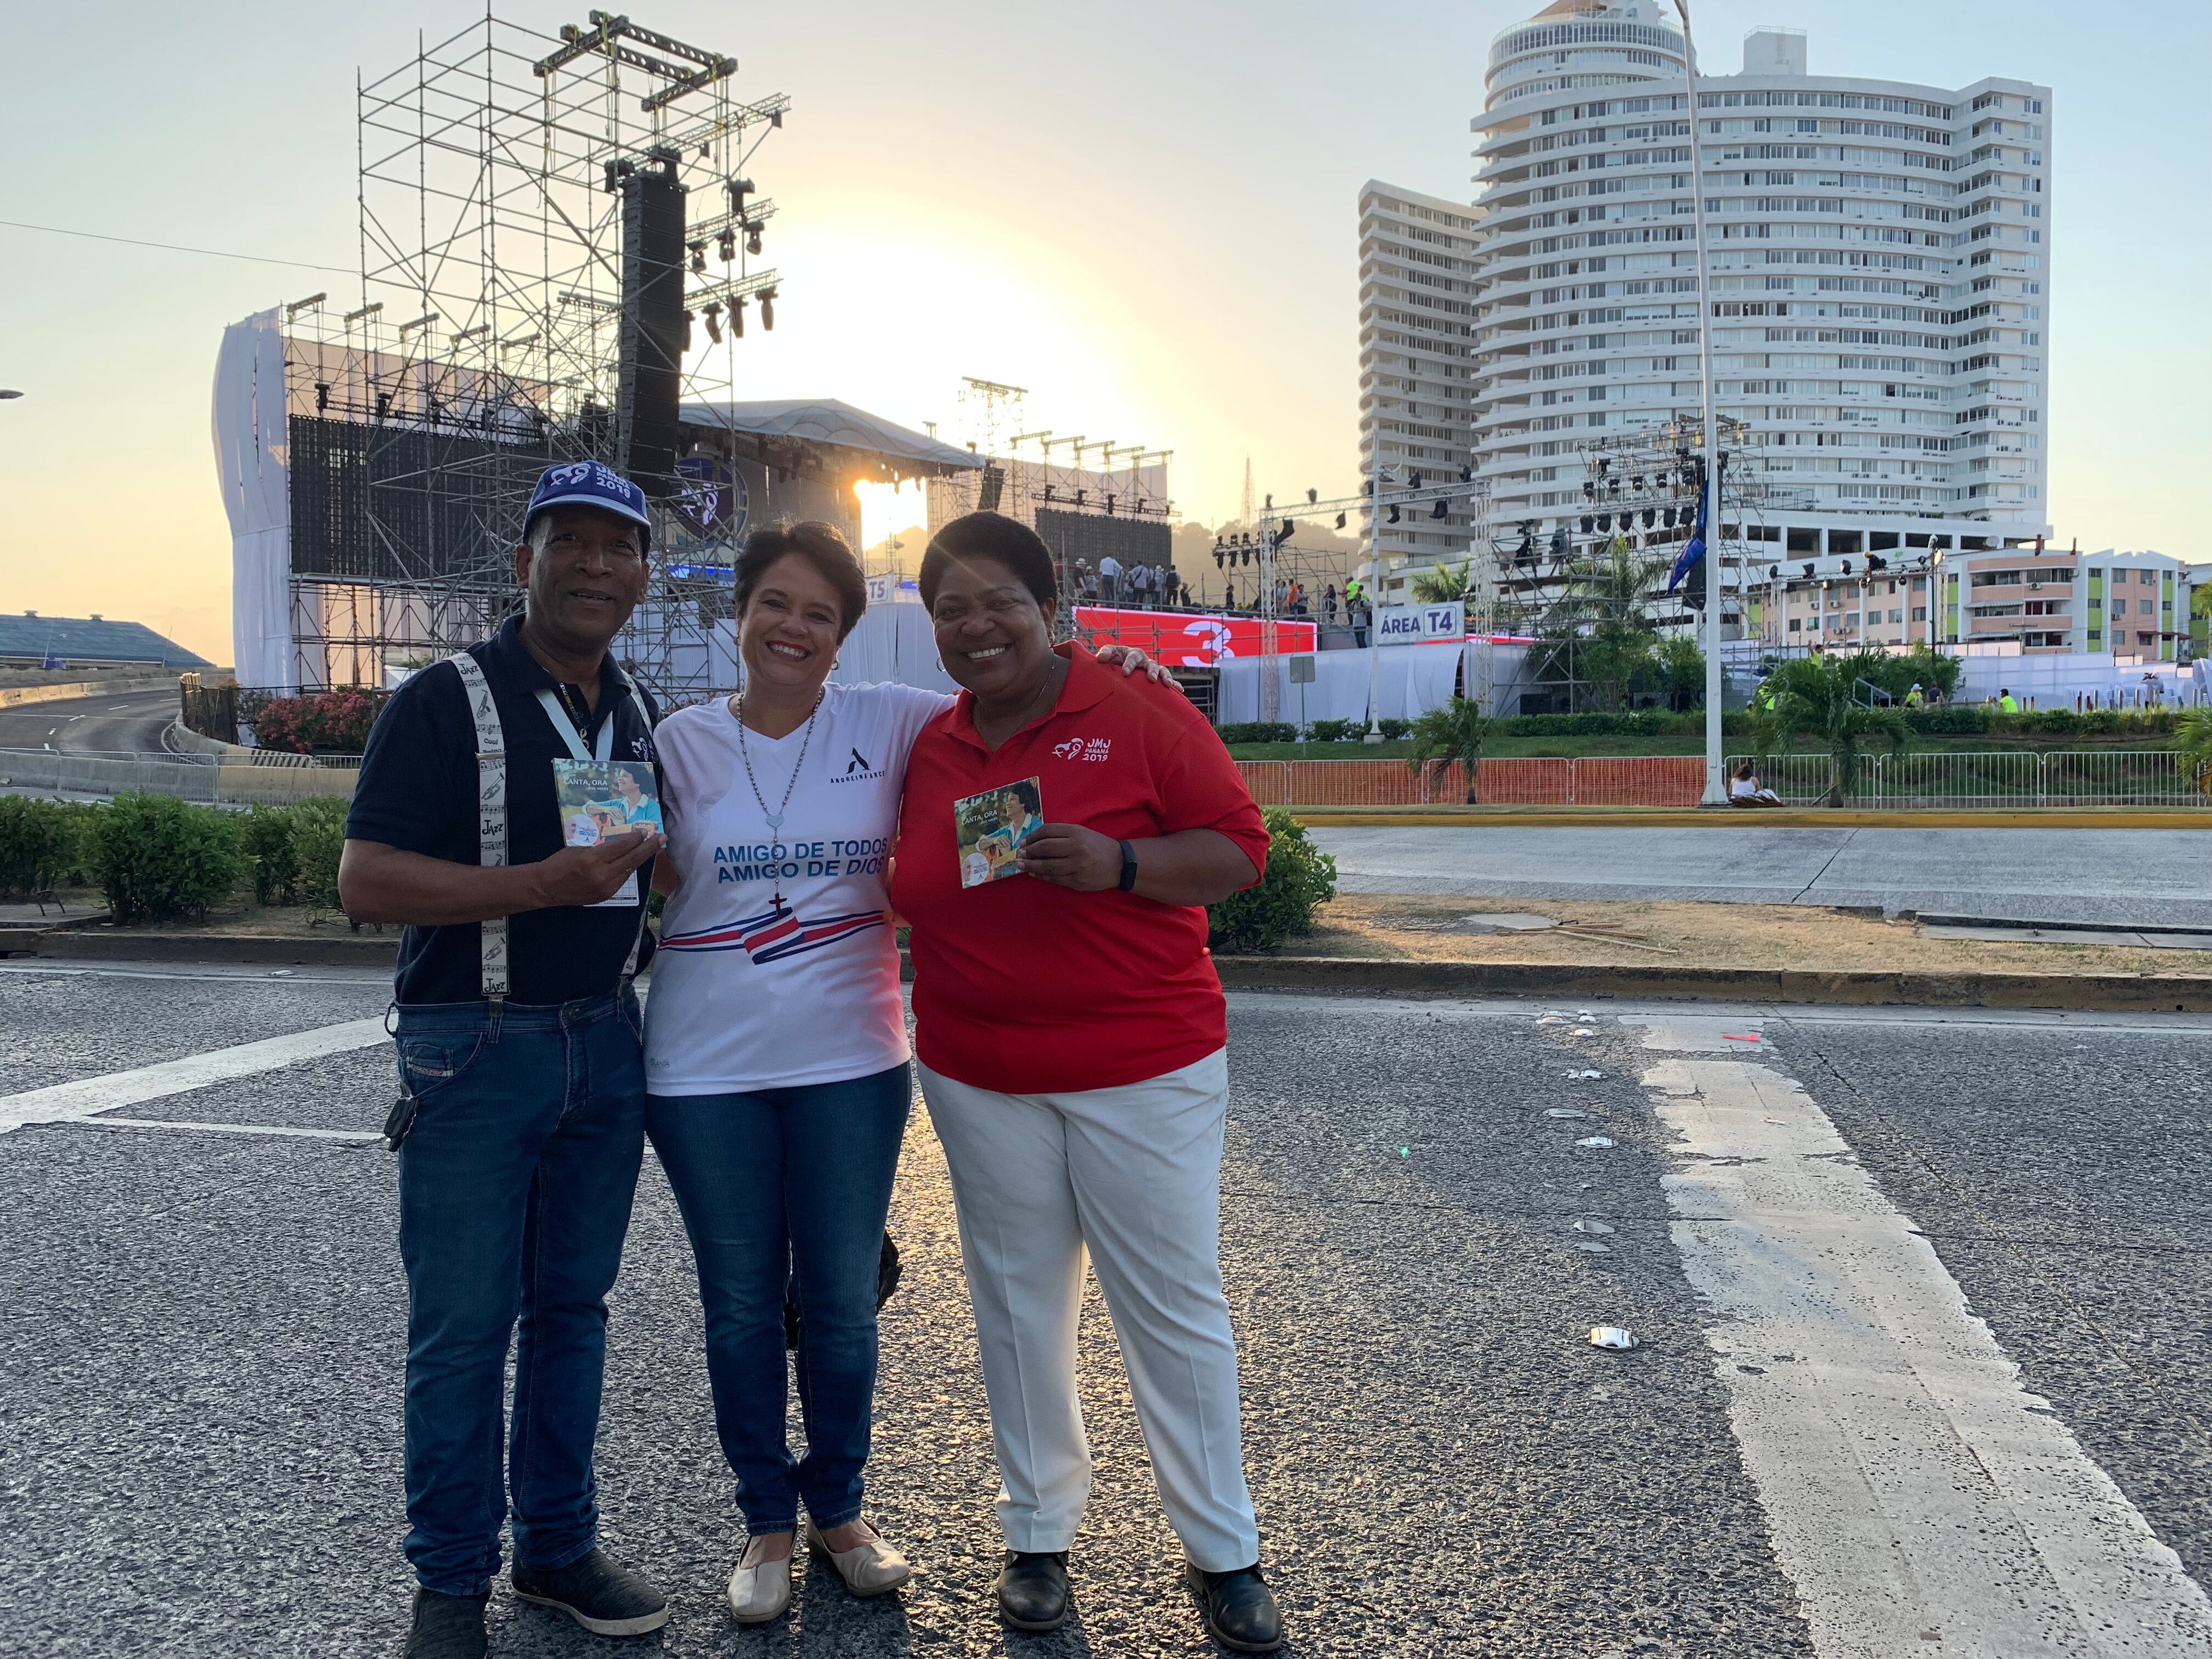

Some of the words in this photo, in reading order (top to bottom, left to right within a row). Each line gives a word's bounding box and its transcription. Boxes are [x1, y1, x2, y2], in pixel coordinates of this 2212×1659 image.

[597, 477, 631, 499] 2019
[869, 581, 885, 599] T5
[1381, 615, 1421, 635] ÁREA
[1427, 611, 1452, 633] T4
[1182, 621, 1235, 668] 3
[1087, 738, 1111, 748] JMJ
[1082, 753, 1108, 761] 2019
[831, 773, 867, 783] ANDREINA
[870, 770, 885, 779] ARCE
[962, 814, 983, 825] CANTA,
[984, 809, 997, 818] ORA
[713, 844, 787, 864] AMIGO
[795, 842, 825, 859] DE
[831, 838, 887, 857] TODOS
[718, 862, 799, 884] AMIGO
[807, 860, 841, 877] DE
[846, 855, 884, 875] DIOS
